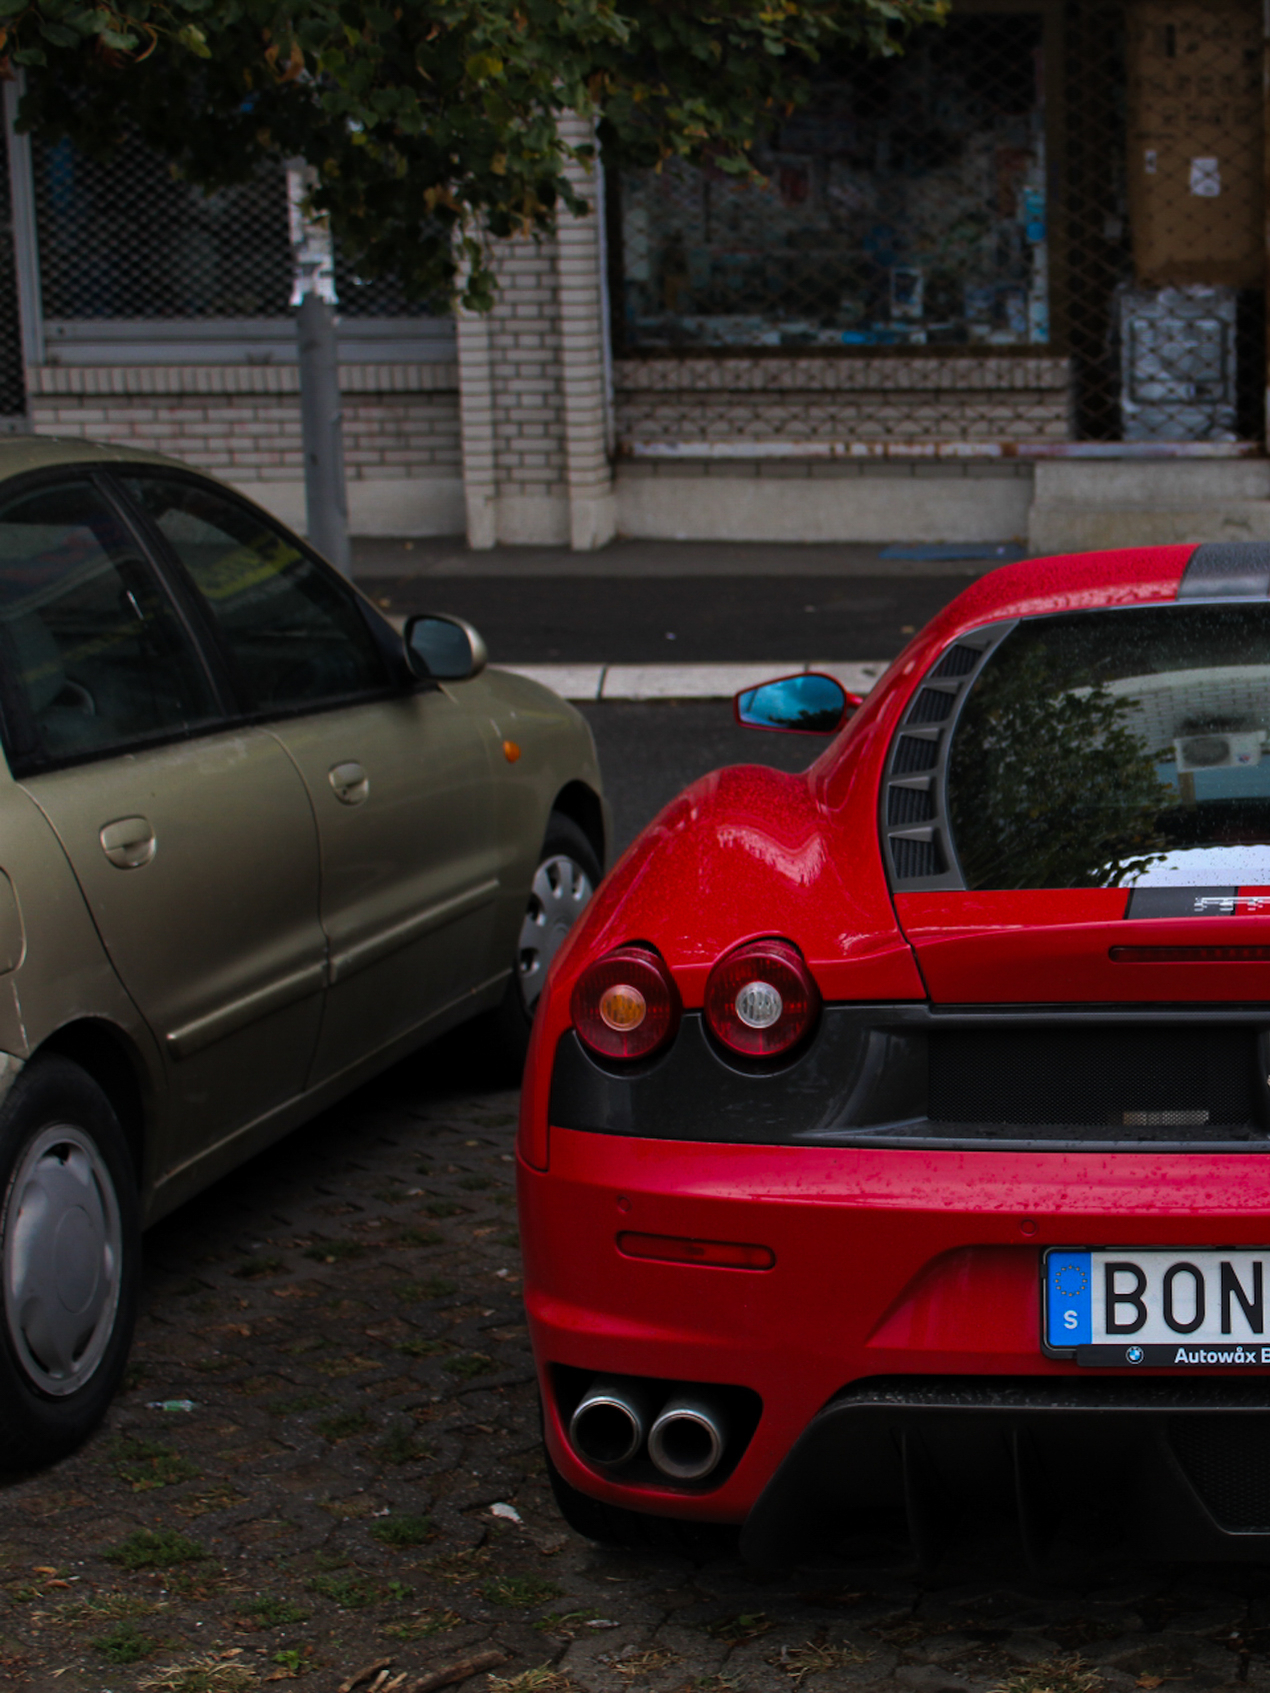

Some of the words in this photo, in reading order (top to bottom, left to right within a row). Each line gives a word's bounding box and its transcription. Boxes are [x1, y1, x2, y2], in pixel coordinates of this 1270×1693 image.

[1104, 1261, 1265, 1335] BON
[1062, 1310, 1079, 1330] S
[1174, 1345, 1256, 1364] Autowåx
